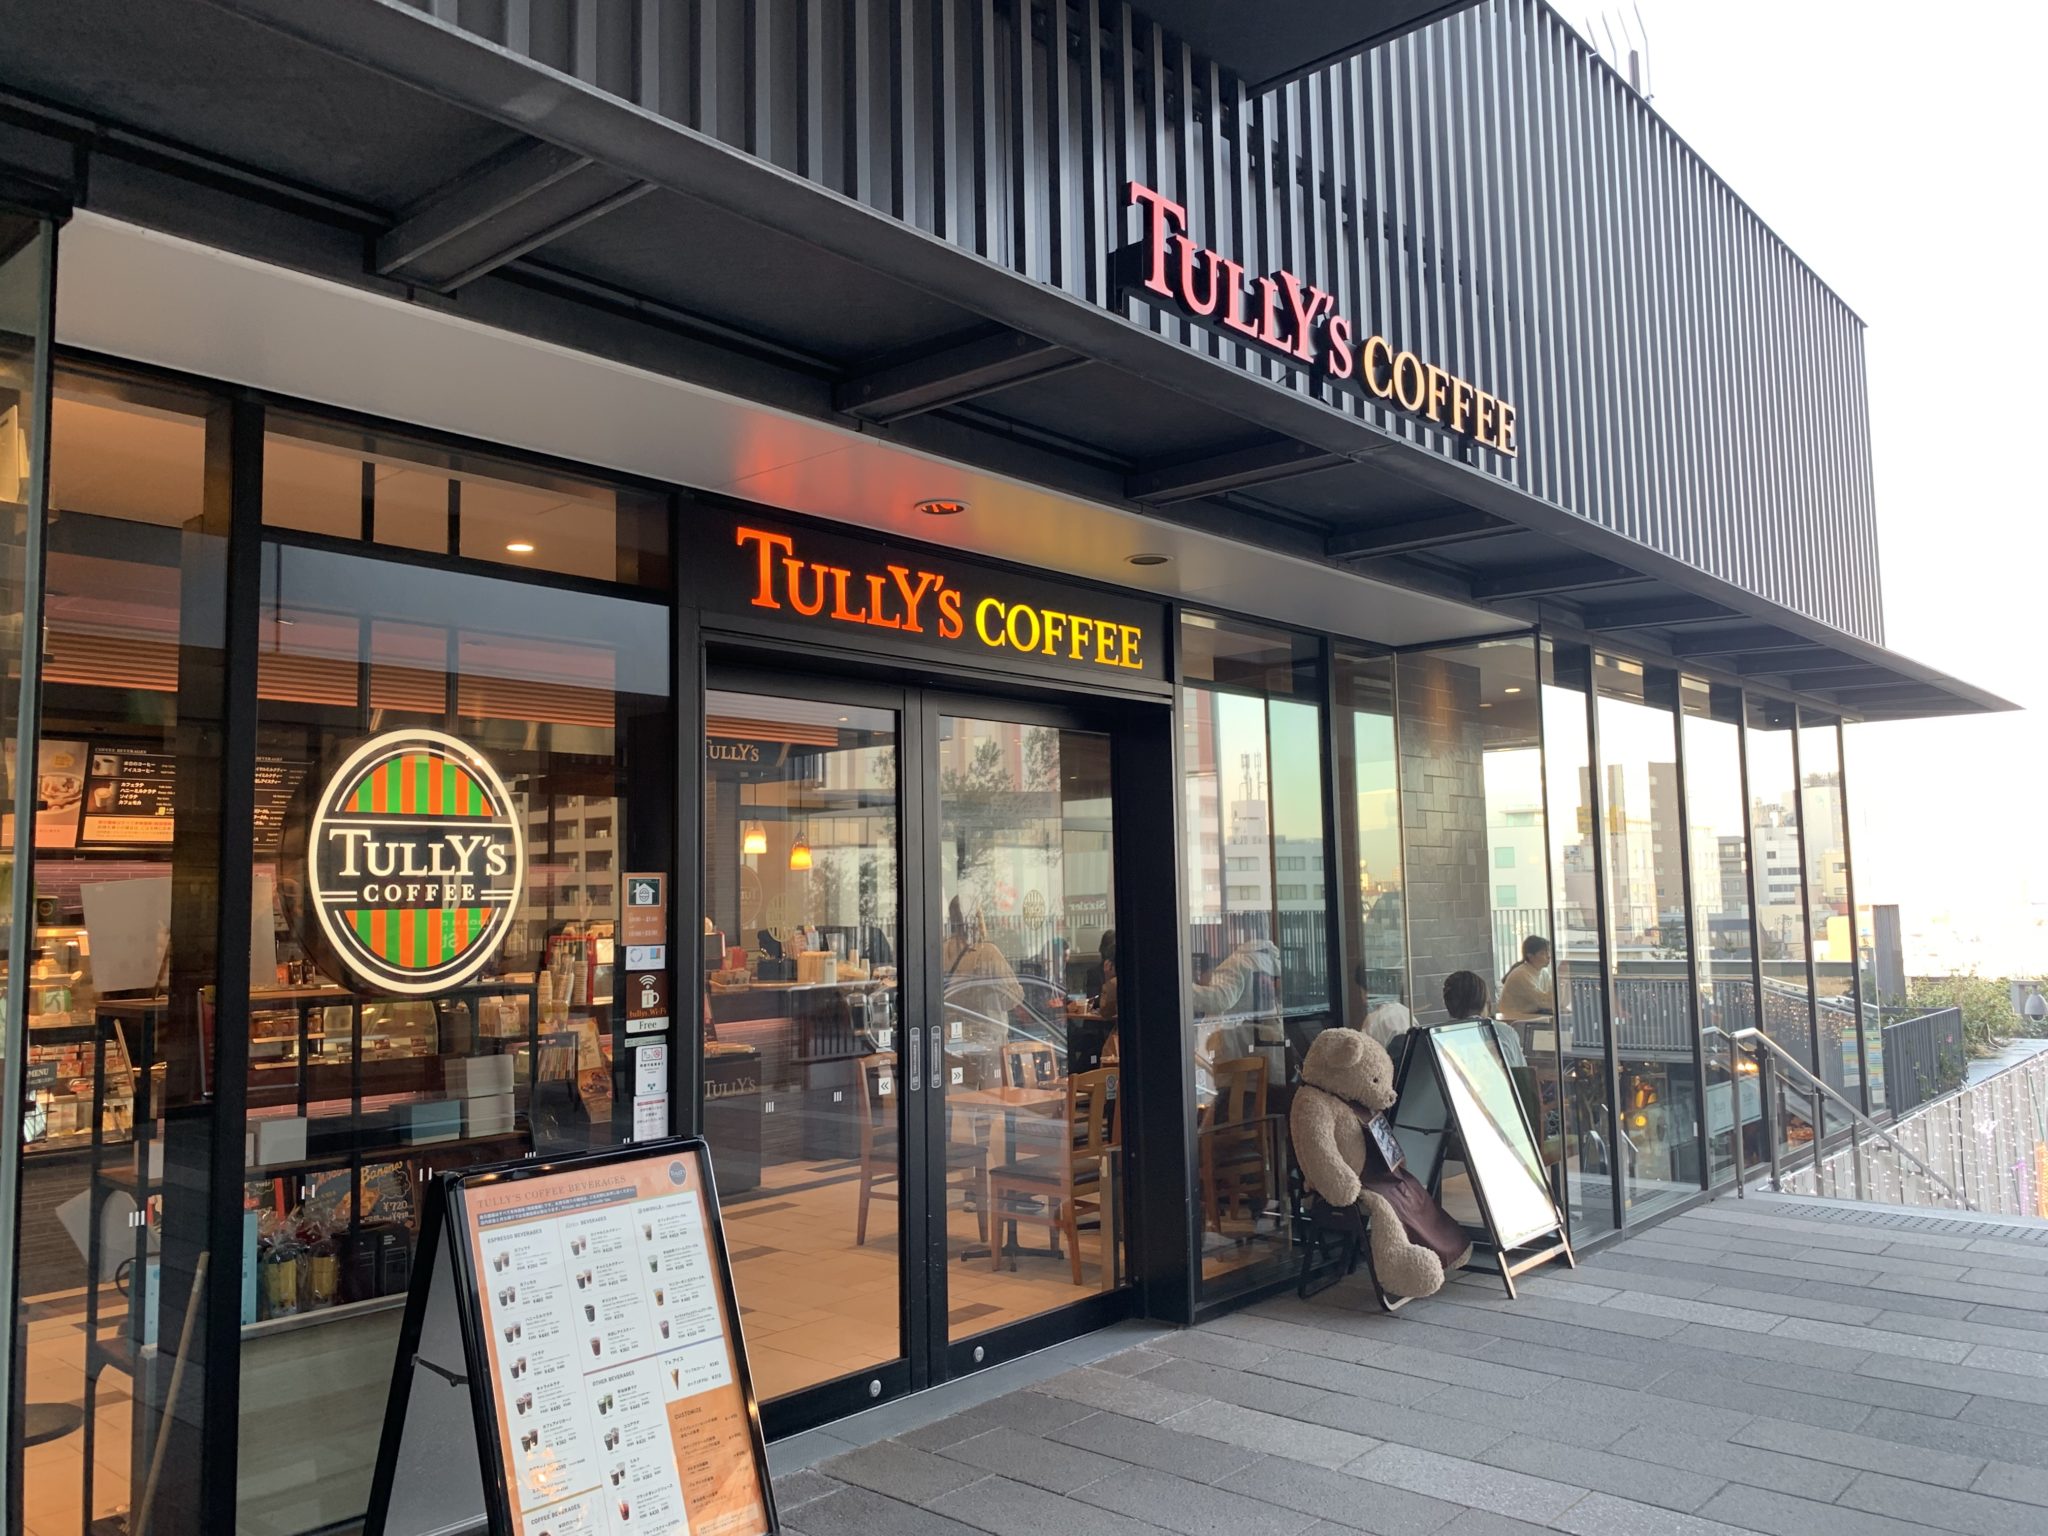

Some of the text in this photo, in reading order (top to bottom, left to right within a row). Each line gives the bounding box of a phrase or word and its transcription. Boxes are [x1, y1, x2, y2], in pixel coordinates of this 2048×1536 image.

[1129, 181, 1518, 458] TULLY'S COFFEE
[736, 526, 1144, 670] TULLY'S COFFEE
[329, 828, 507, 877] TULLY'S
[362, 883, 475, 903] COFFEE
[638, 1020, 657, 1030] Free
[704, 1076, 756, 1098] TULLY'S
[478, 1174, 627, 1209] TULLY'S COFFEE BEVERAGES
[580, 1215, 607, 1226] BEVERAGES
[514, 1228, 543, 1239] BEVERAGES
[592, 1369, 635, 1387] OTHER BEVERAGES
[530, 1513, 551, 1525] COFFEE
